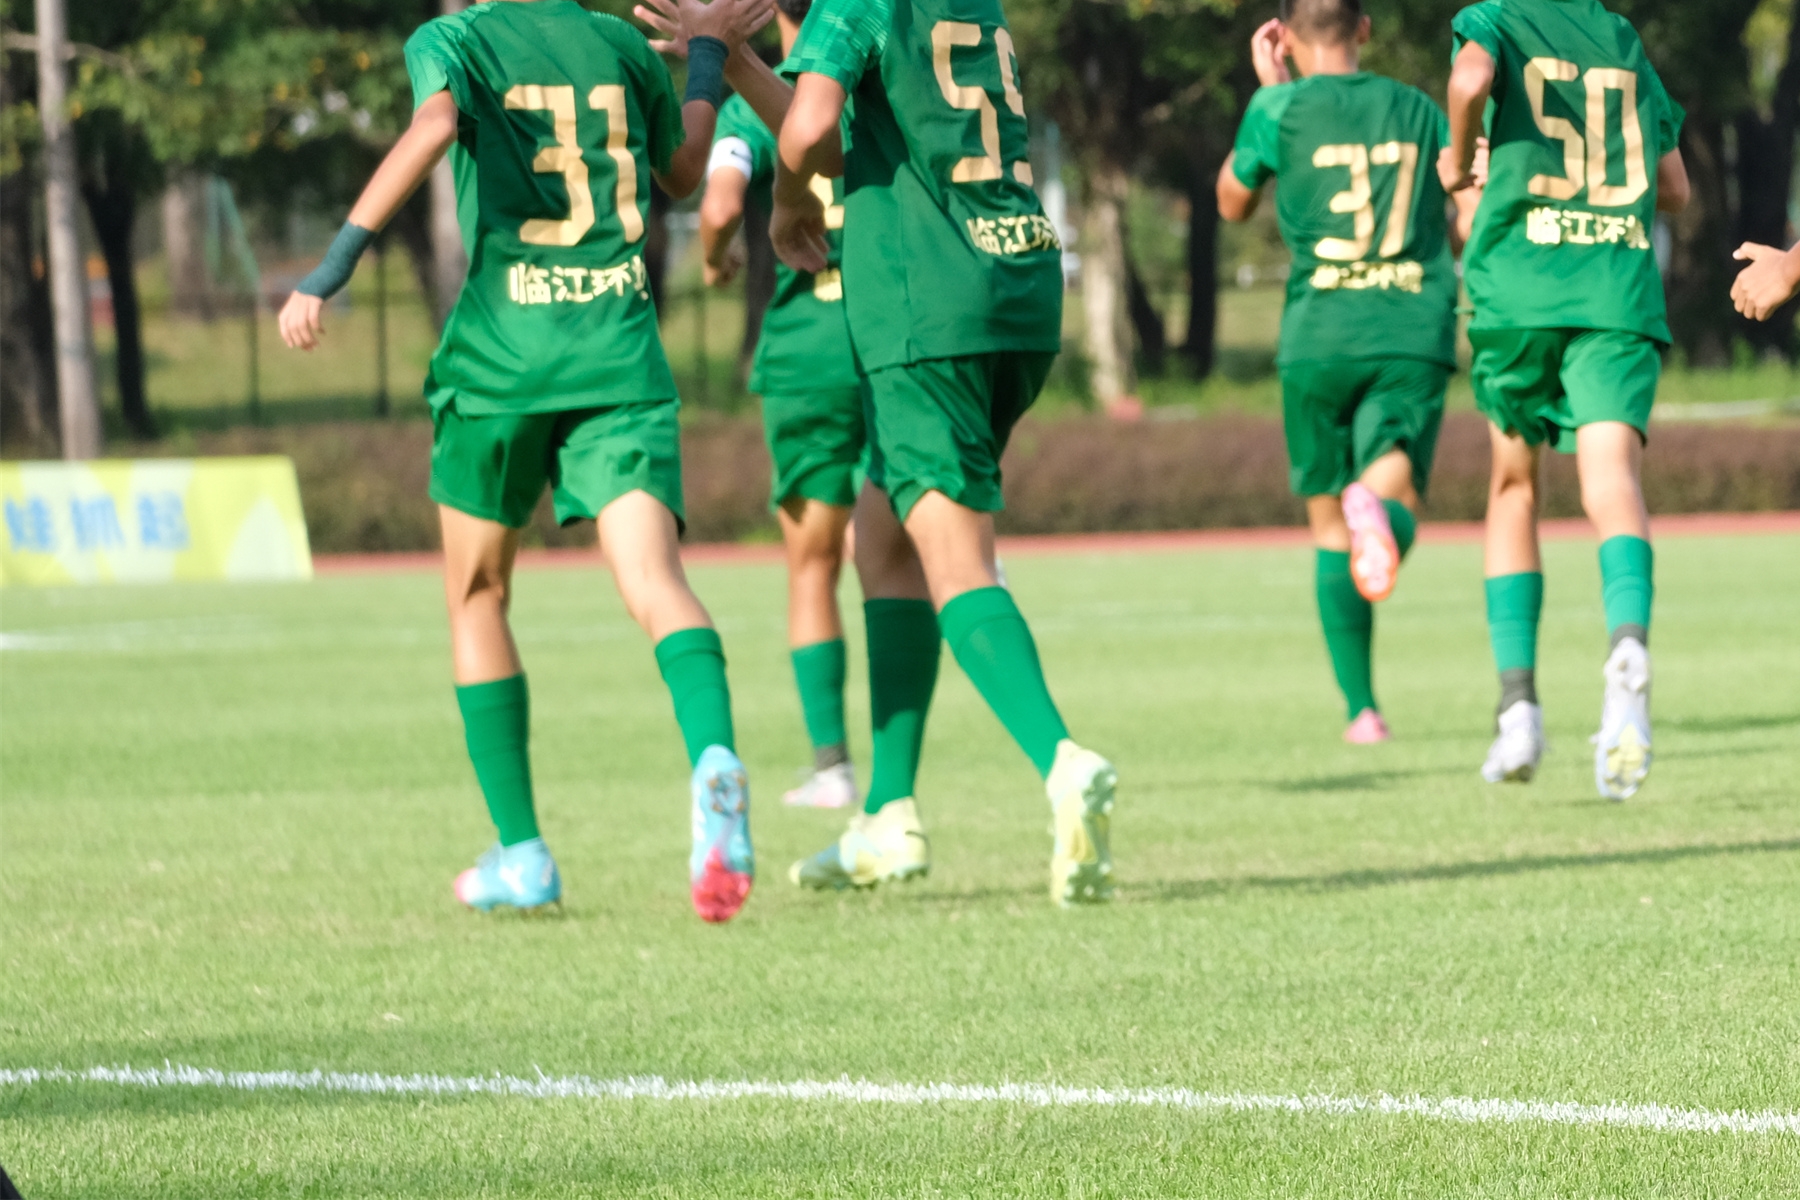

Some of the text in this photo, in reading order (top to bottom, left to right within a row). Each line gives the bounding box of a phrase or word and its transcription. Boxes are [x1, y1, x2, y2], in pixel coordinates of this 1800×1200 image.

[503, 84, 645, 246] 31
[1312, 141, 1418, 260] 37
[1523, 56, 1649, 206] 50
